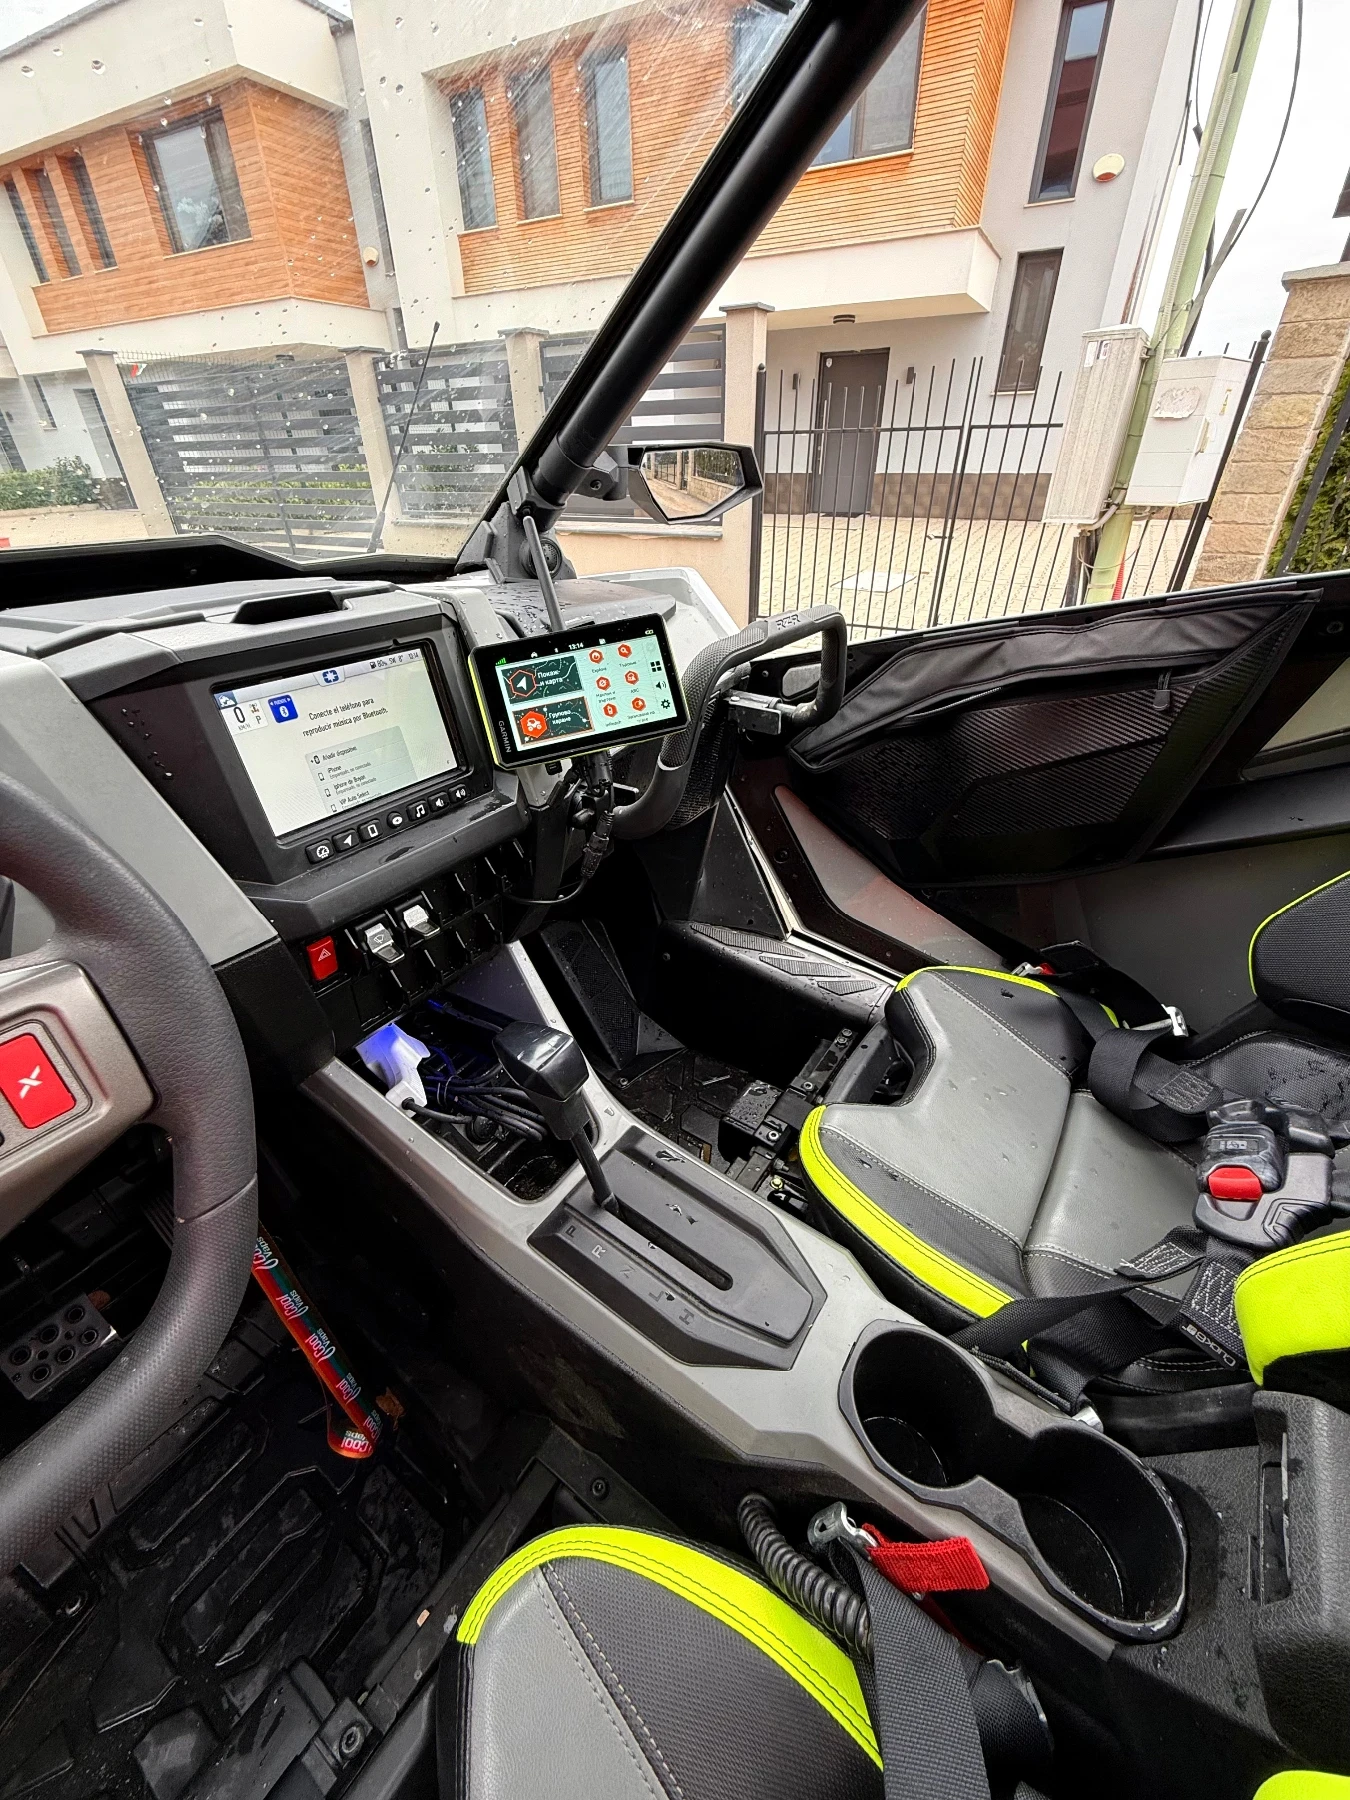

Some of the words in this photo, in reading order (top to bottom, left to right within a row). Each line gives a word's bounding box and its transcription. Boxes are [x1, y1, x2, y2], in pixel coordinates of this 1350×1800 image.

[776, 614, 800, 630] RZR
[568, 642, 584, 650] 13:14
[233, 706, 245, 723] 0
[308, 708, 333, 720] Conecte
[340, 701, 361, 712] teléfono
[362, 698, 374, 708] para
[256, 715, 261, 724] P
[302, 722, 332, 737] reproducir
[332, 717, 353, 727] música
[353, 715, 362, 724] por
[362, 707, 388, 719] Bluetooth.
[499, 720, 511, 752] GARMIN
[592, 1244, 606, 1259] R
[619, 1264, 636, 1279] N
[679, 1308, 695, 1325] H
[276, 1294, 298, 1316] Cool
[290, 1290, 304, 1308] Vaps
[305, 1333, 325, 1358] Cool
[317, 1328, 330, 1347] Vaps
[336, 1378, 353, 1400] Cool
[346, 1372, 357, 1389] Vaps
[341, 1437, 369, 1453] Cool
